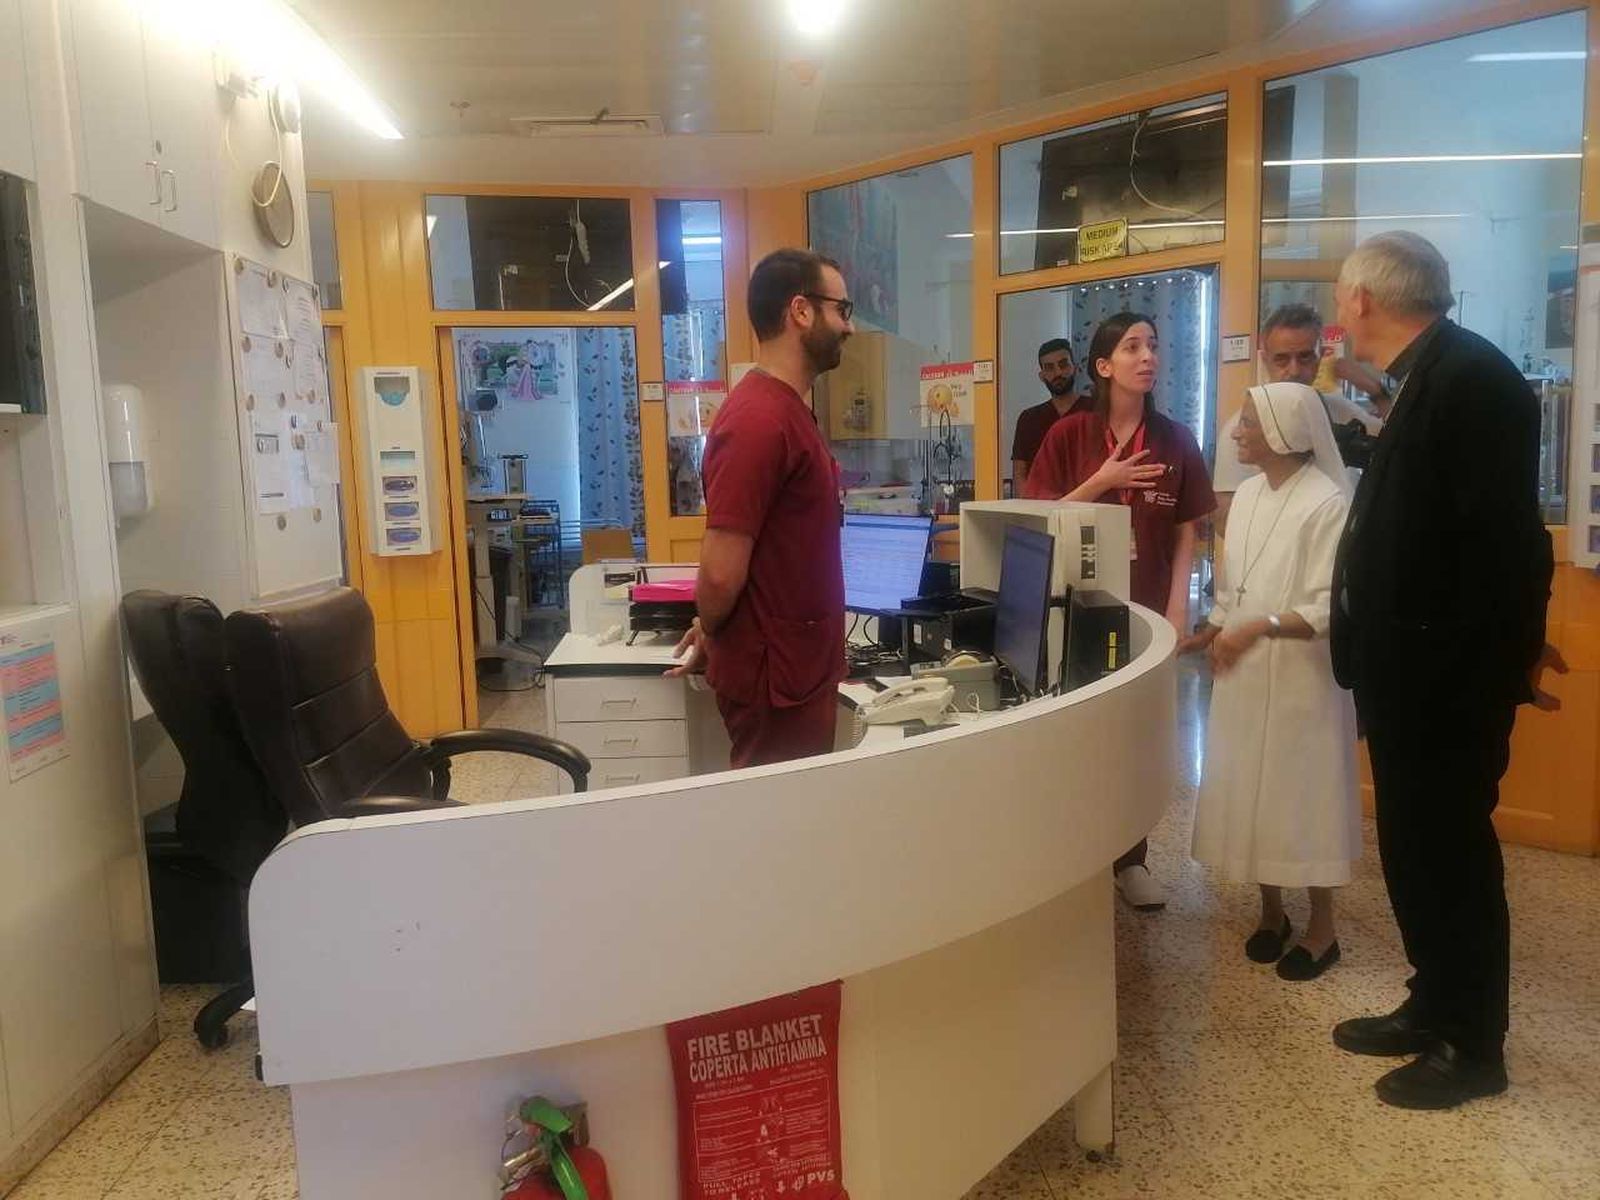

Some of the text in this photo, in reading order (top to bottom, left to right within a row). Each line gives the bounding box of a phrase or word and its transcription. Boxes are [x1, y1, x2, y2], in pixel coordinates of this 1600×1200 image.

[1086, 226, 1119, 241] MEDIUM
[1080, 244, 1102, 257] RISK
[687, 1015, 823, 1061] FIRE BLANKET
[689, 1054, 748, 1083] COPERTA
[751, 1037, 827, 1072] ANTIFIAMMA
